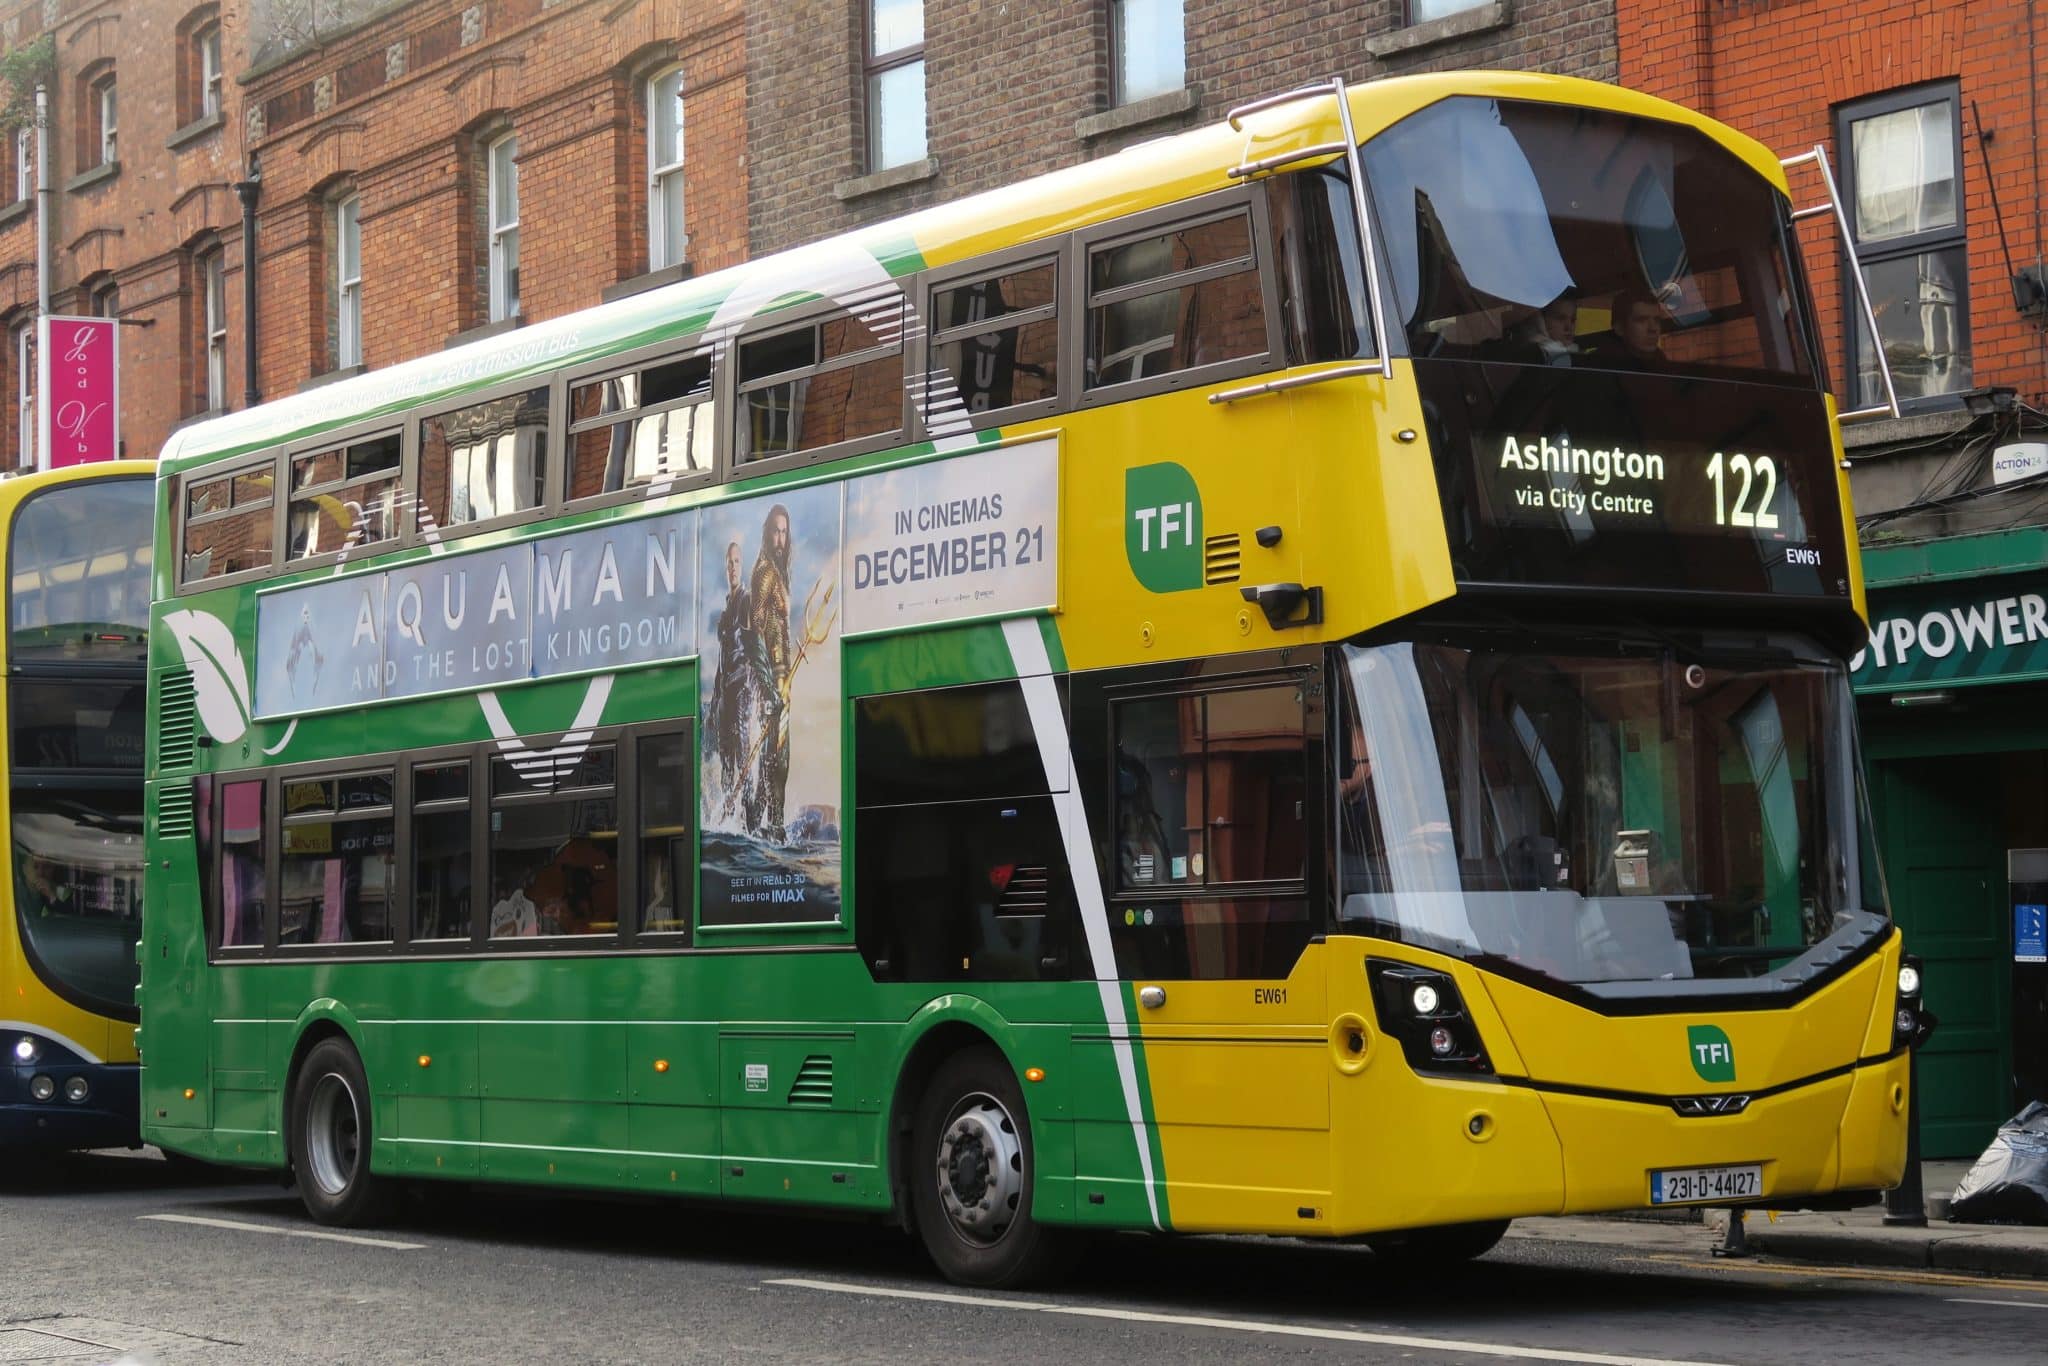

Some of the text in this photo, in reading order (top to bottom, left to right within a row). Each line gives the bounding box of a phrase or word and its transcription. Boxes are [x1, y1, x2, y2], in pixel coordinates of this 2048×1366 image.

[1500, 436, 1665, 485] Ashington
[1515, 485, 1654, 515] via City Centre
[1706, 452, 1779, 529] 122
[895, 493, 1003, 535] IN CINEMAS
[1135, 501, 1193, 552] TFI
[854, 525, 1043, 590] DECEMBER 21
[1786, 548, 1822, 566] EW61
[352, 529, 677, 648] AQUAMAN
[350, 615, 676, 691] AND THE LOST KINGDOM
[731, 878, 745, 888] SEE
[746, 877, 752, 886] IT
[754, 877, 762, 886] IN
[731, 888, 806, 903] FILMED FOR IMAX
[1254, 988, 1287, 1005] EW61
[1695, 1042, 1730, 1065] TFI
[1669, 1172, 1755, 1199] 231-D-44127
